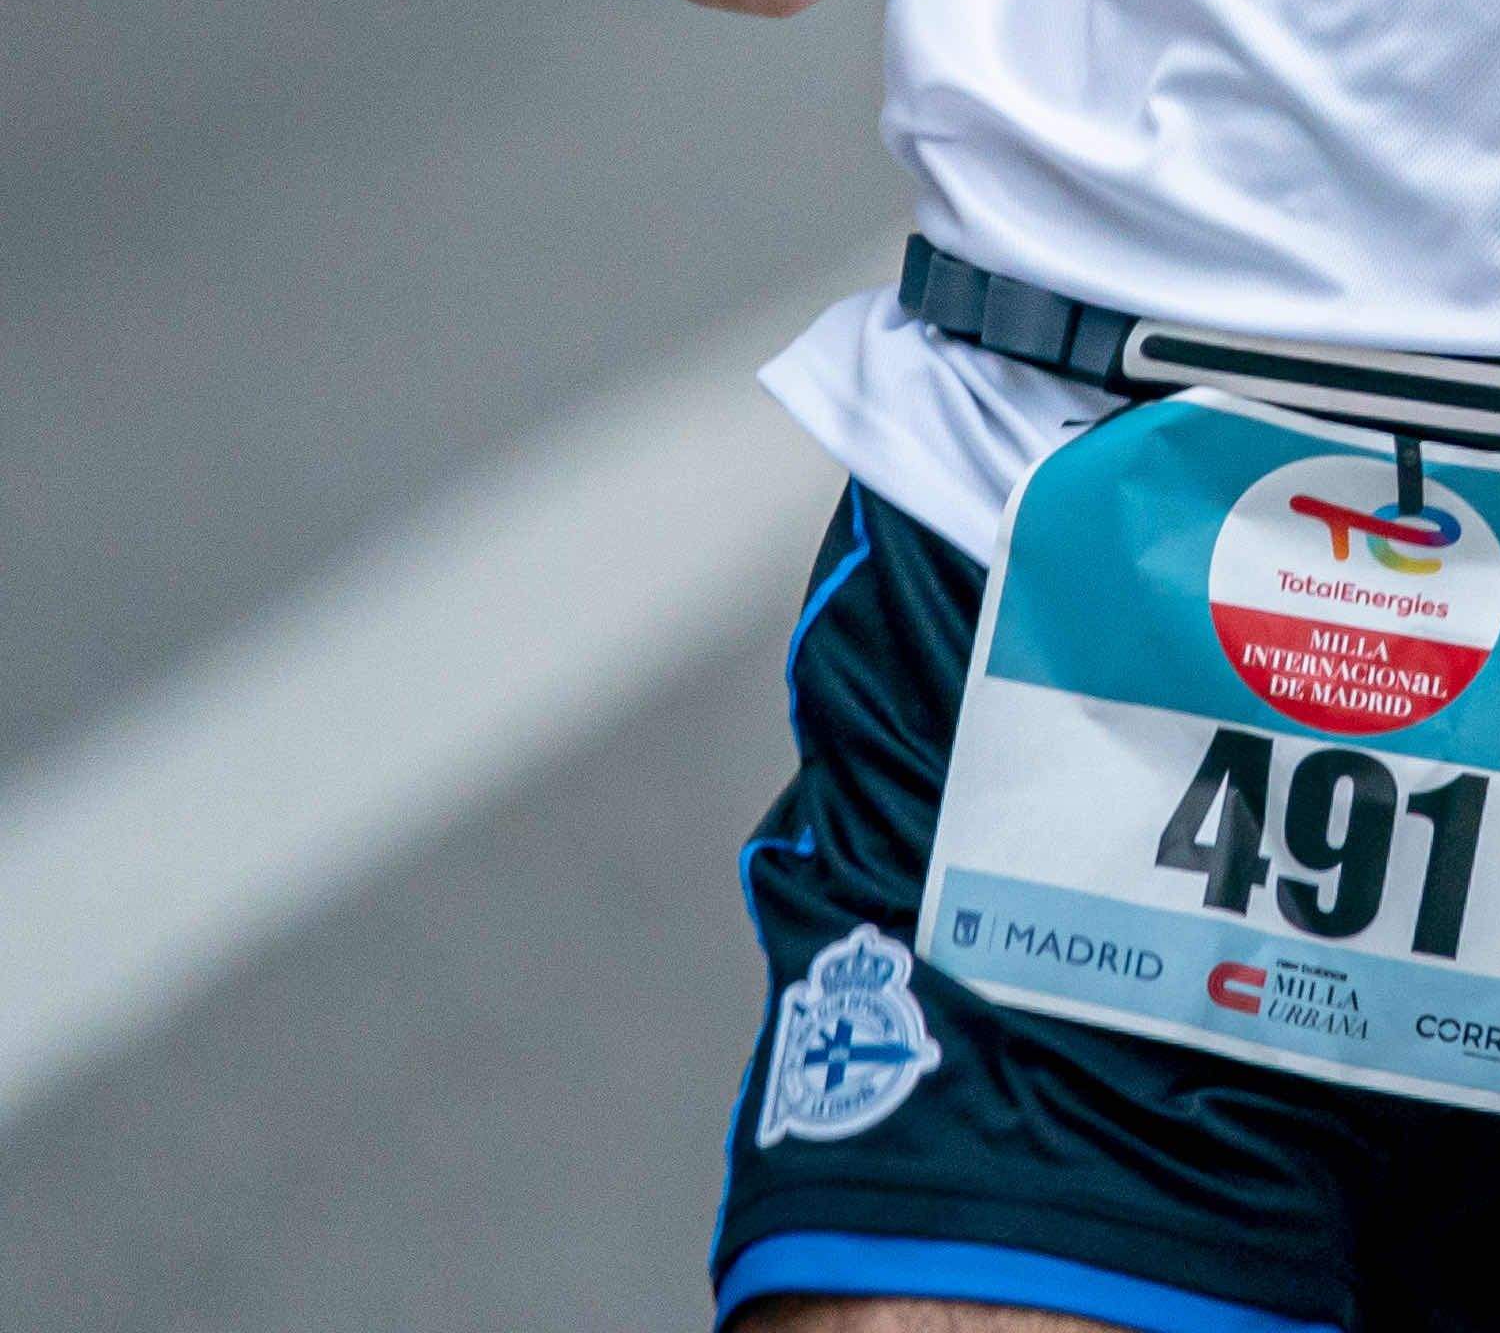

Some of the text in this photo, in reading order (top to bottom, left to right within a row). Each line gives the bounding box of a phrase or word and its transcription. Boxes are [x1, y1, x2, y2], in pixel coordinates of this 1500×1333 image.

[1277, 569, 1449, 618] TotalEnergies
[1310, 629, 1389, 662] MILLA
[1270, 674, 1413, 718] DE MADRID
[1155, 727, 1489, 960] 491
[1005, 921, 1163, 981] MADRID
[1273, 973, 1359, 1011] MILLA
[1268, 998, 1368, 1040] URBANA
